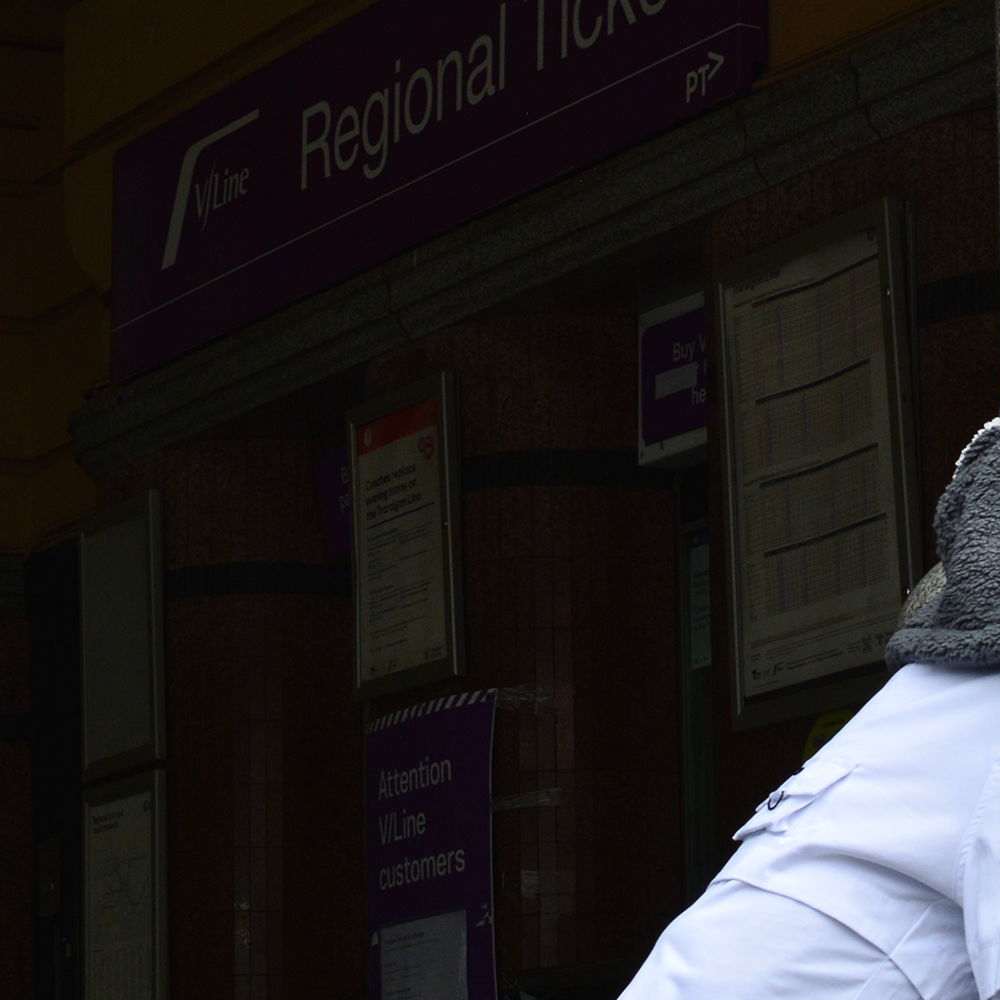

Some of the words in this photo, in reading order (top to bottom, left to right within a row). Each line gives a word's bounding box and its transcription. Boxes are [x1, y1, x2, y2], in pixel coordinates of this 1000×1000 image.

[300, 1, 507, 191] Regional
[672, 340, 696, 363] Buy
[378, 755, 452, 802] Attention
[378, 808, 427, 846] V/Line
[379, 848, 466, 891] customers
